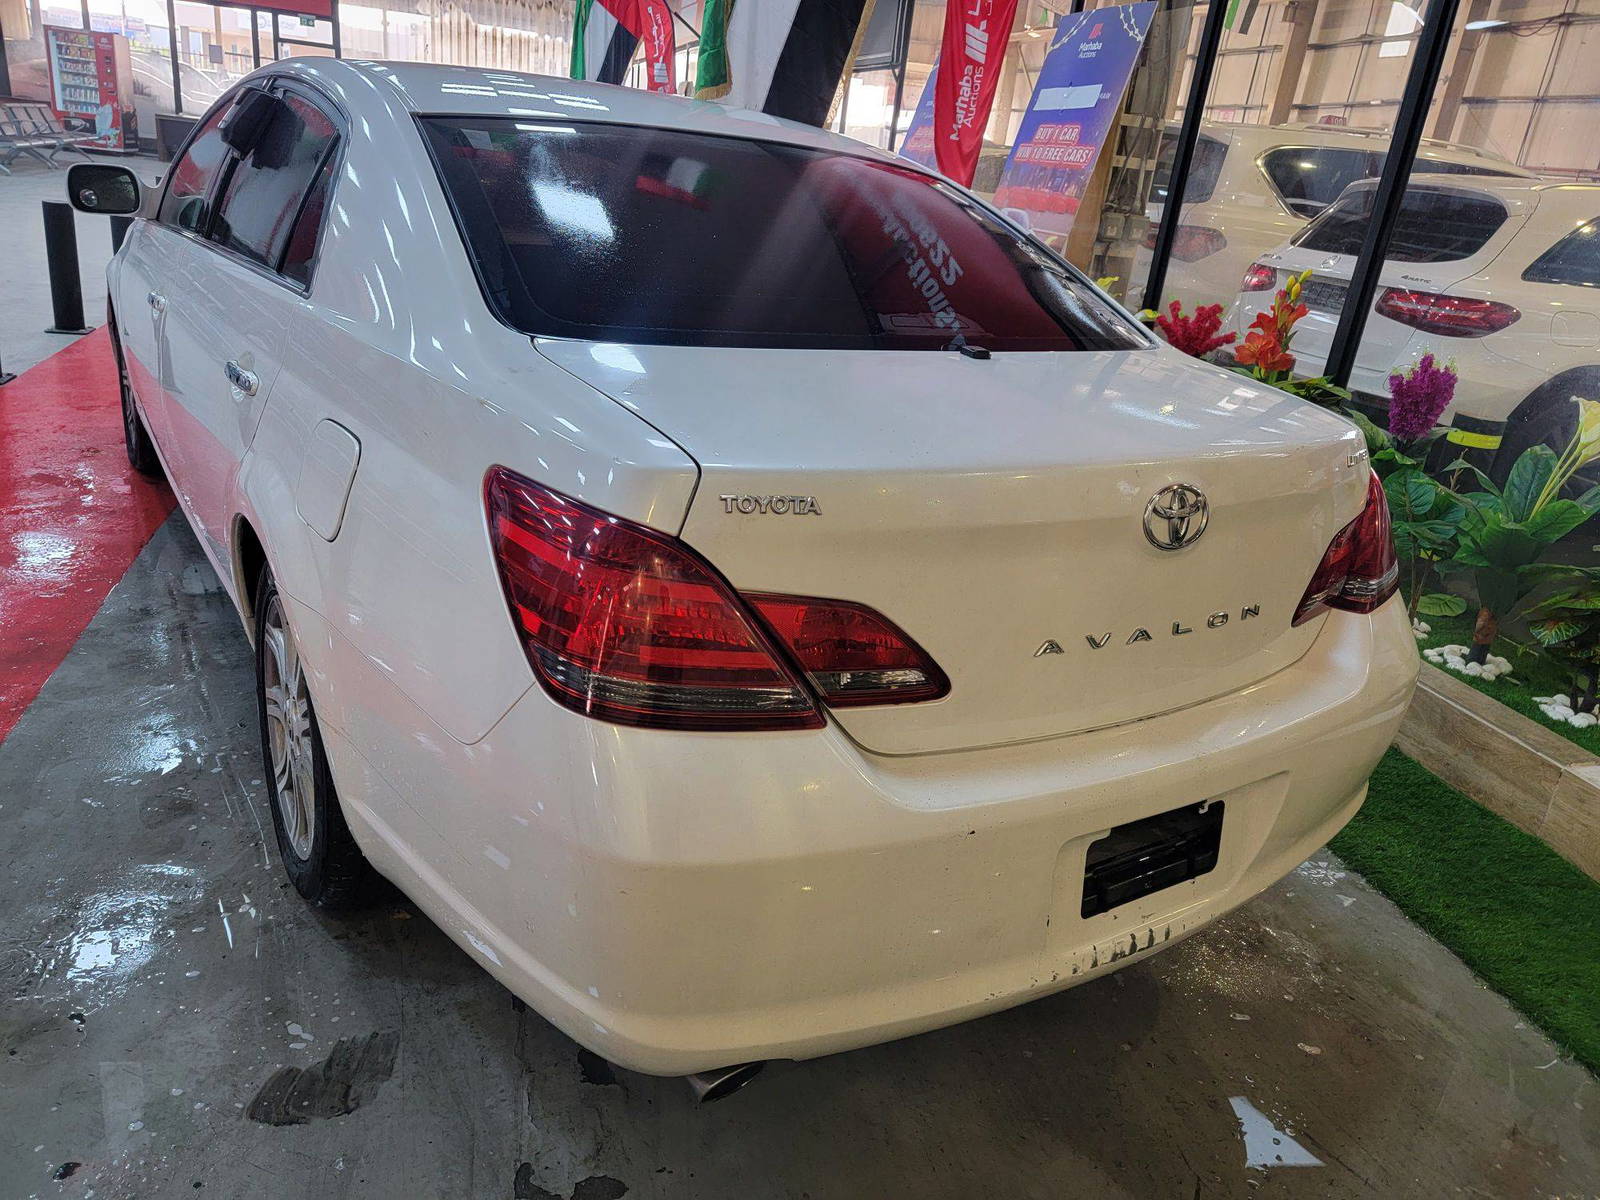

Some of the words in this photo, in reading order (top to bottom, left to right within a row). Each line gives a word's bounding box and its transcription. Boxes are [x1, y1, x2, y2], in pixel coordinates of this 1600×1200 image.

[949, 64, 974, 141] Marhaba
[963, 66, 984, 129] Auctions
[1036, 127, 1053, 140] BUY
[1042, 147, 1063, 160] FREE
[1063, 148, 1093, 163] CARS!
[719, 493, 822, 515] TOYOTA
[1033, 603, 1260, 657] AVALON
